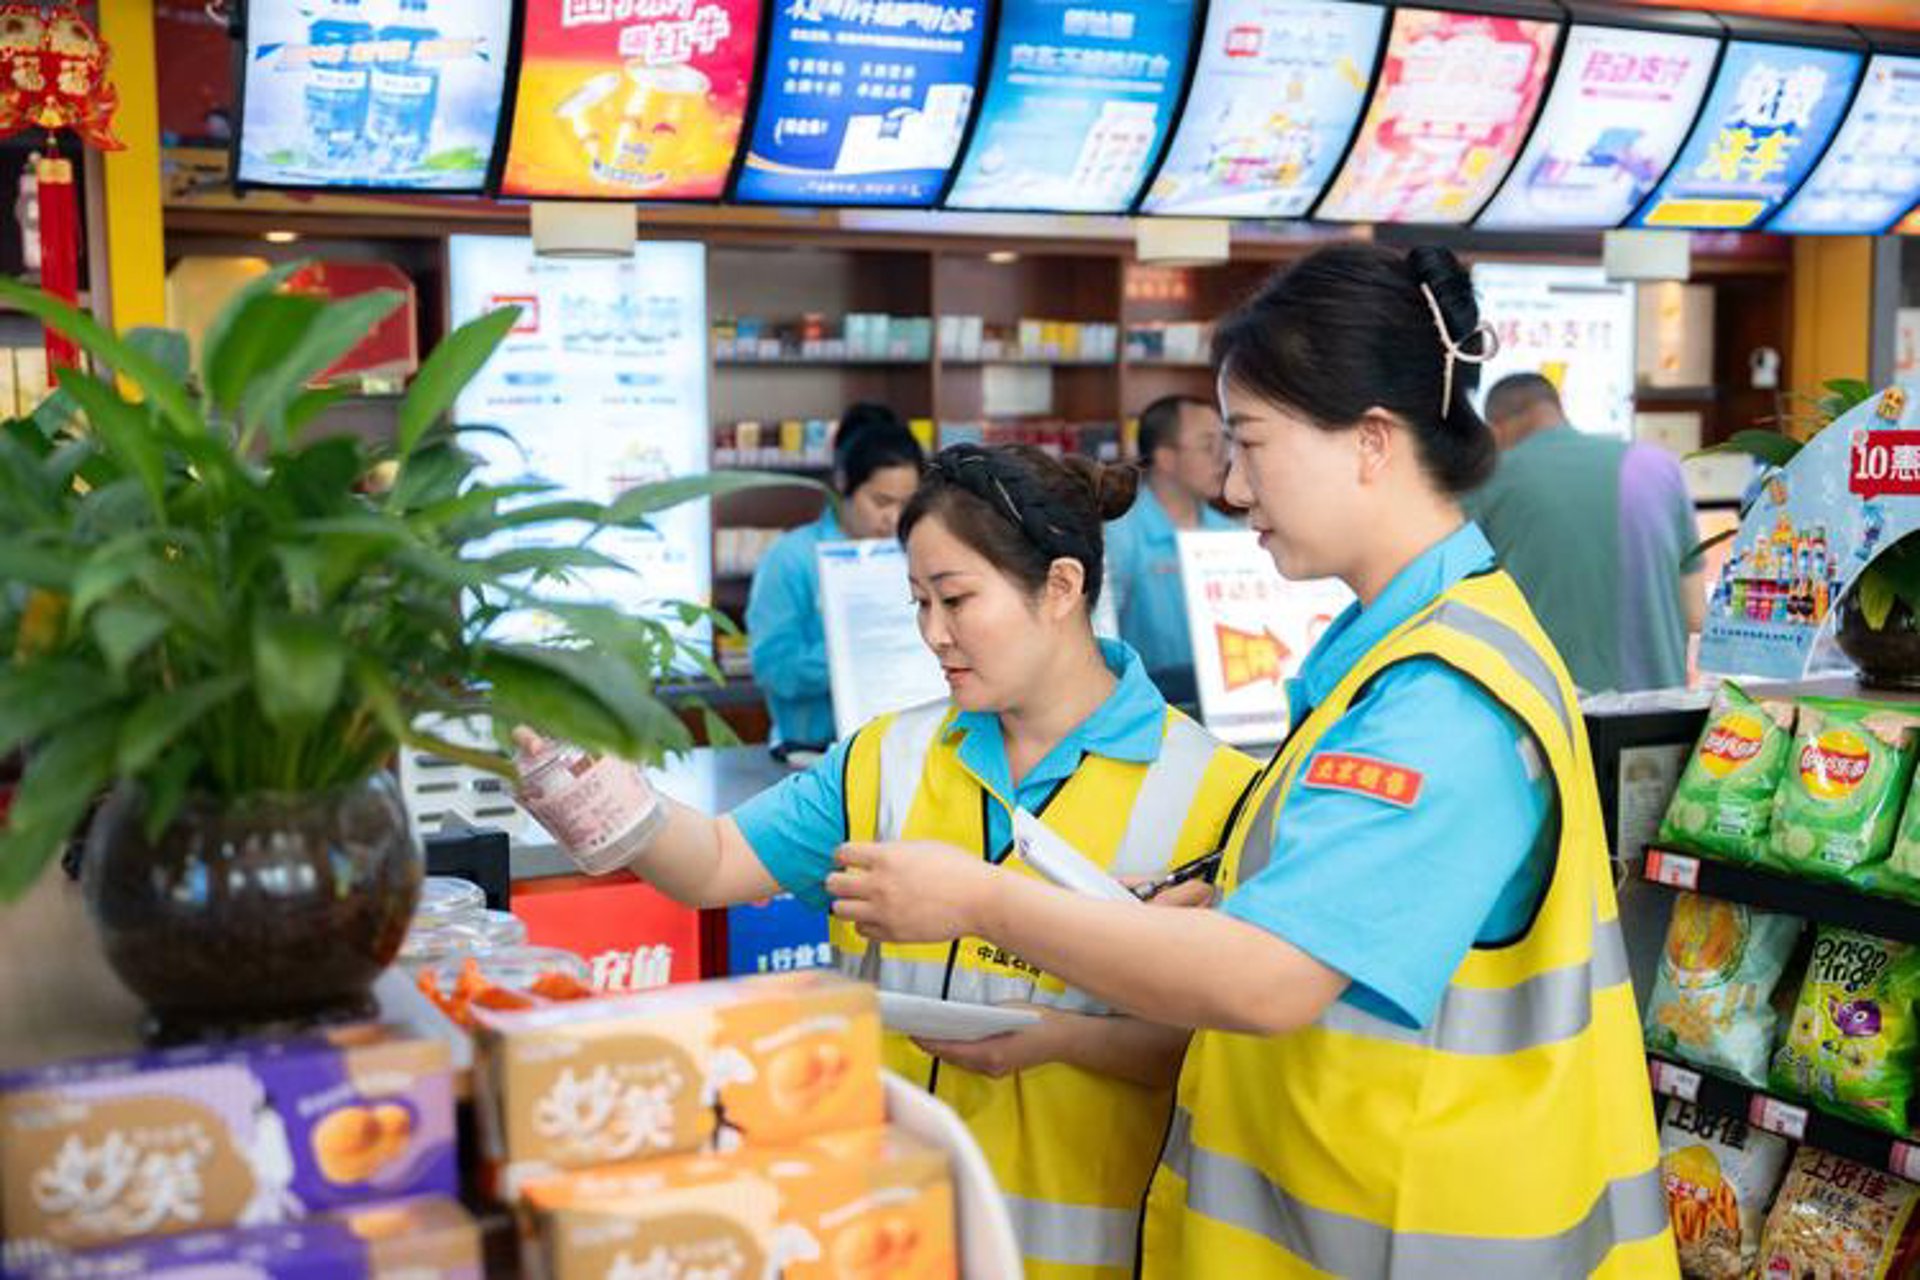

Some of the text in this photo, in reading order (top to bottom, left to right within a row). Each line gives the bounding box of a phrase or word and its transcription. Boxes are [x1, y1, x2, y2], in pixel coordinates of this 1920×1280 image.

[1582, 48, 1691, 86] 移动支付
[1802, 1158, 1888, 1204] 上好佳
